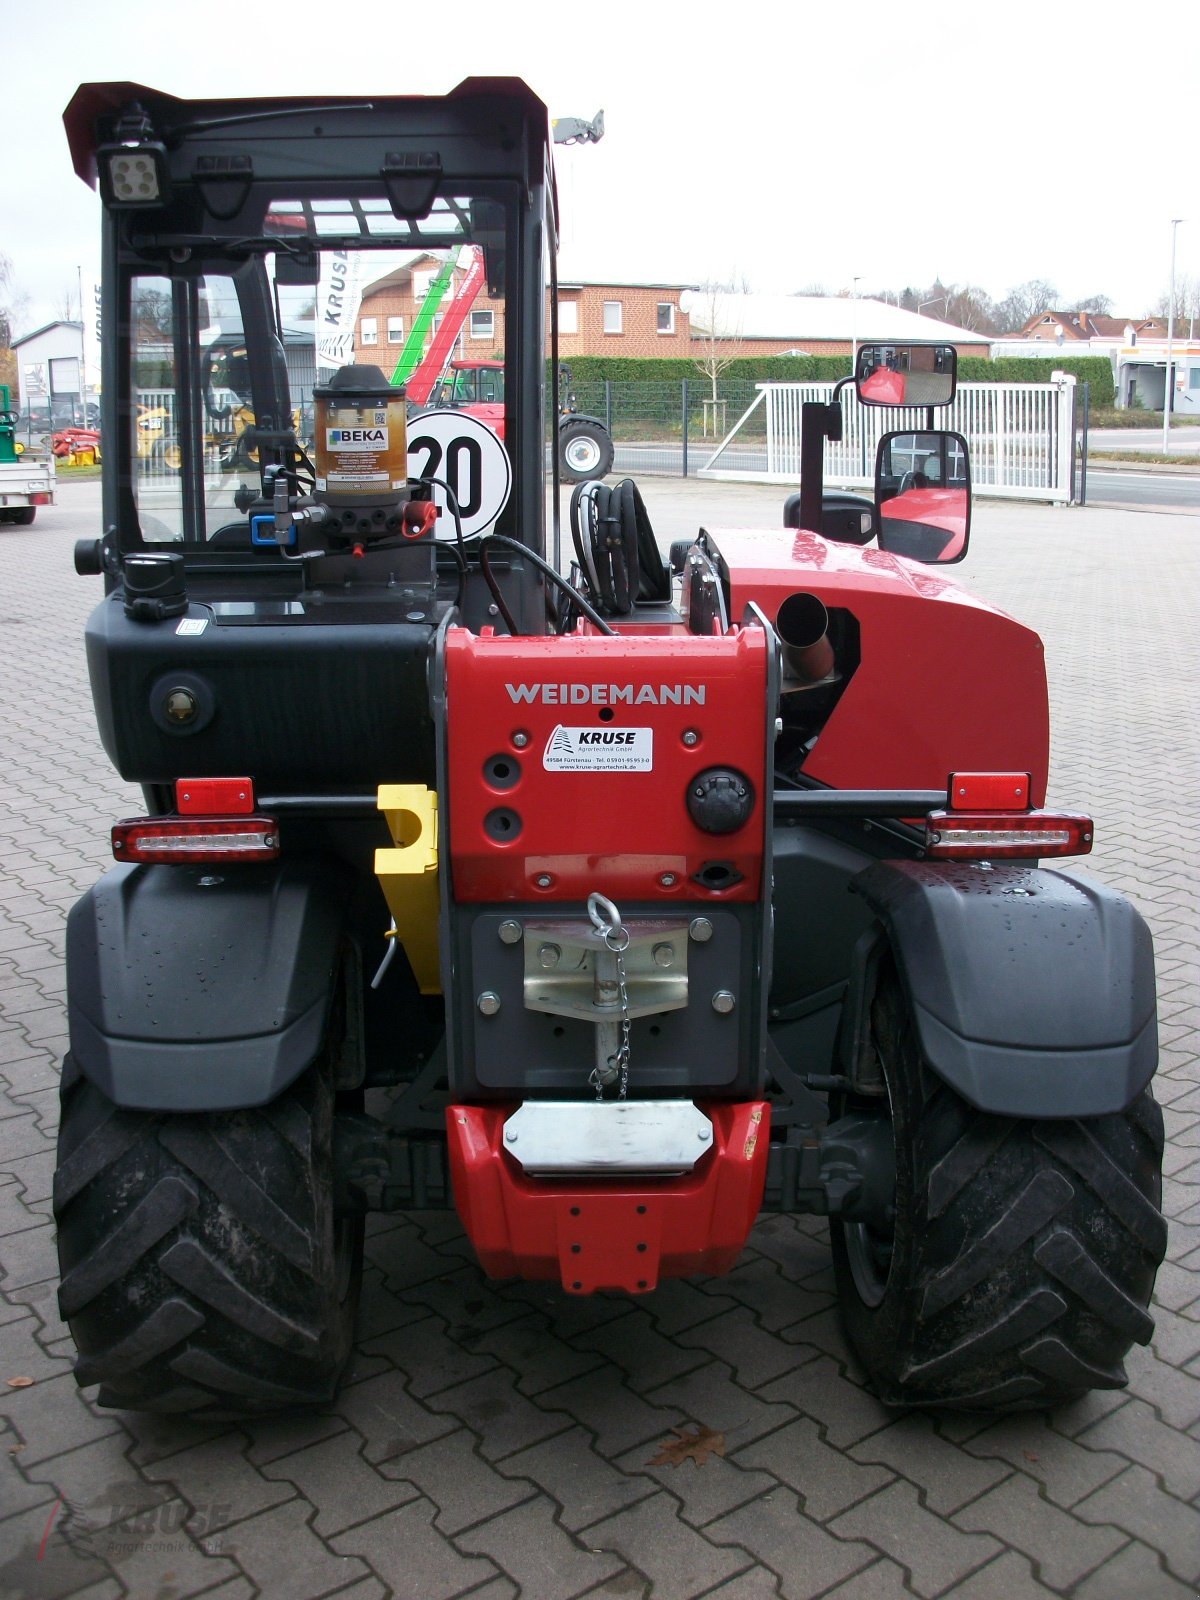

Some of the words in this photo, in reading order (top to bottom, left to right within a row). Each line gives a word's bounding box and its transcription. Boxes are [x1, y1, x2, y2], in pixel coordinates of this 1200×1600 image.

[342, 431, 384, 441] BEKA
[408, 436, 481, 518] 20
[505, 684, 705, 704] WEIDEMANN
[579, 732, 636, 744] KRUSE
